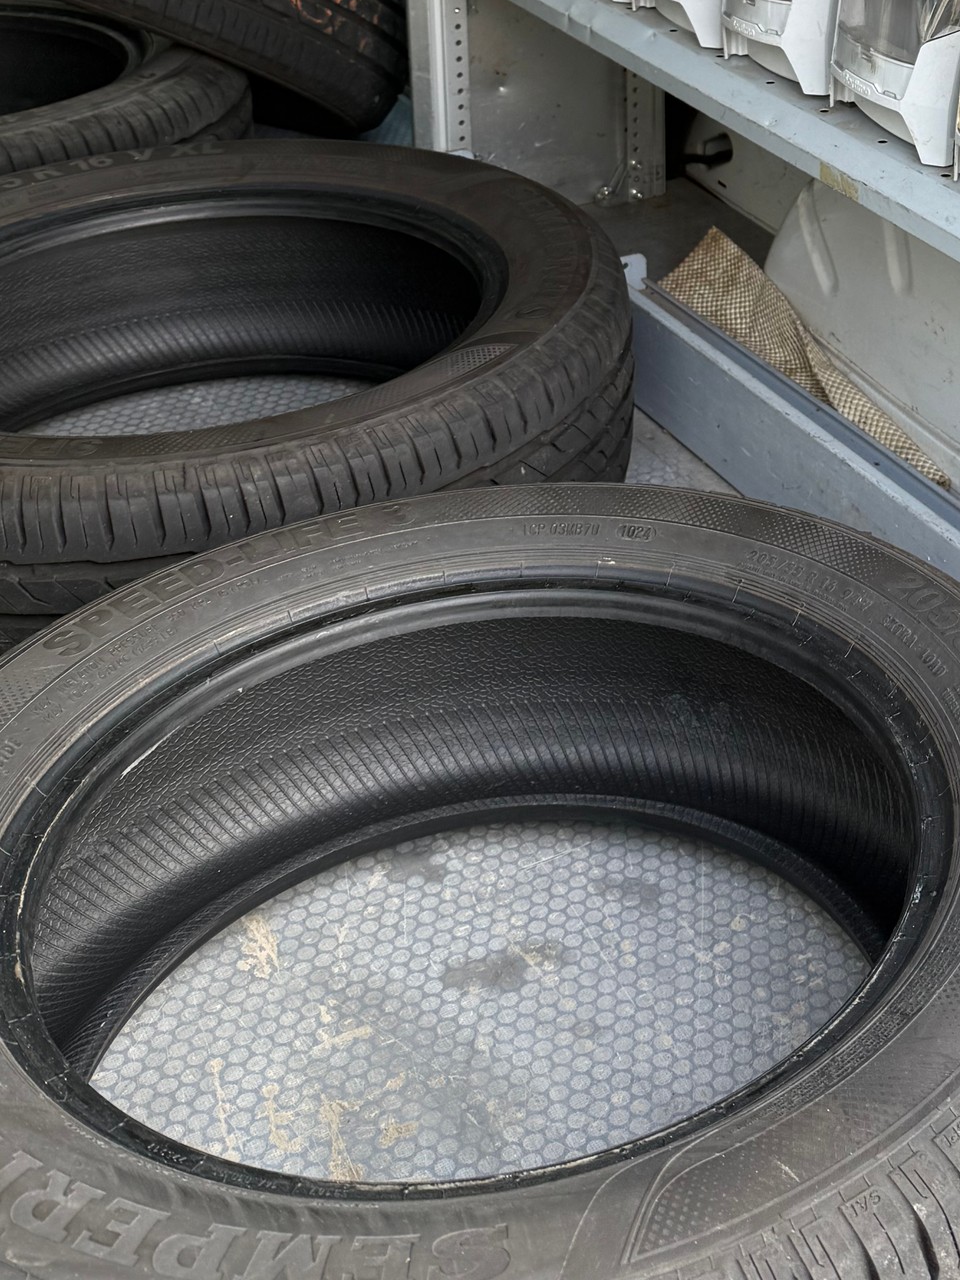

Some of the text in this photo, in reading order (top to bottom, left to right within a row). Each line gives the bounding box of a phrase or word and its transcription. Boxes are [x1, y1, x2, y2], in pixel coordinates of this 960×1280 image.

[69, 154, 114, 173] 16
[127, 147, 155, 162] V
[172, 142, 226, 157] XL
[0, 437, 103, 458] SPE
[620, 524, 652, 540] 1024
[43, 513, 367, 657] SPEED-LIFE
